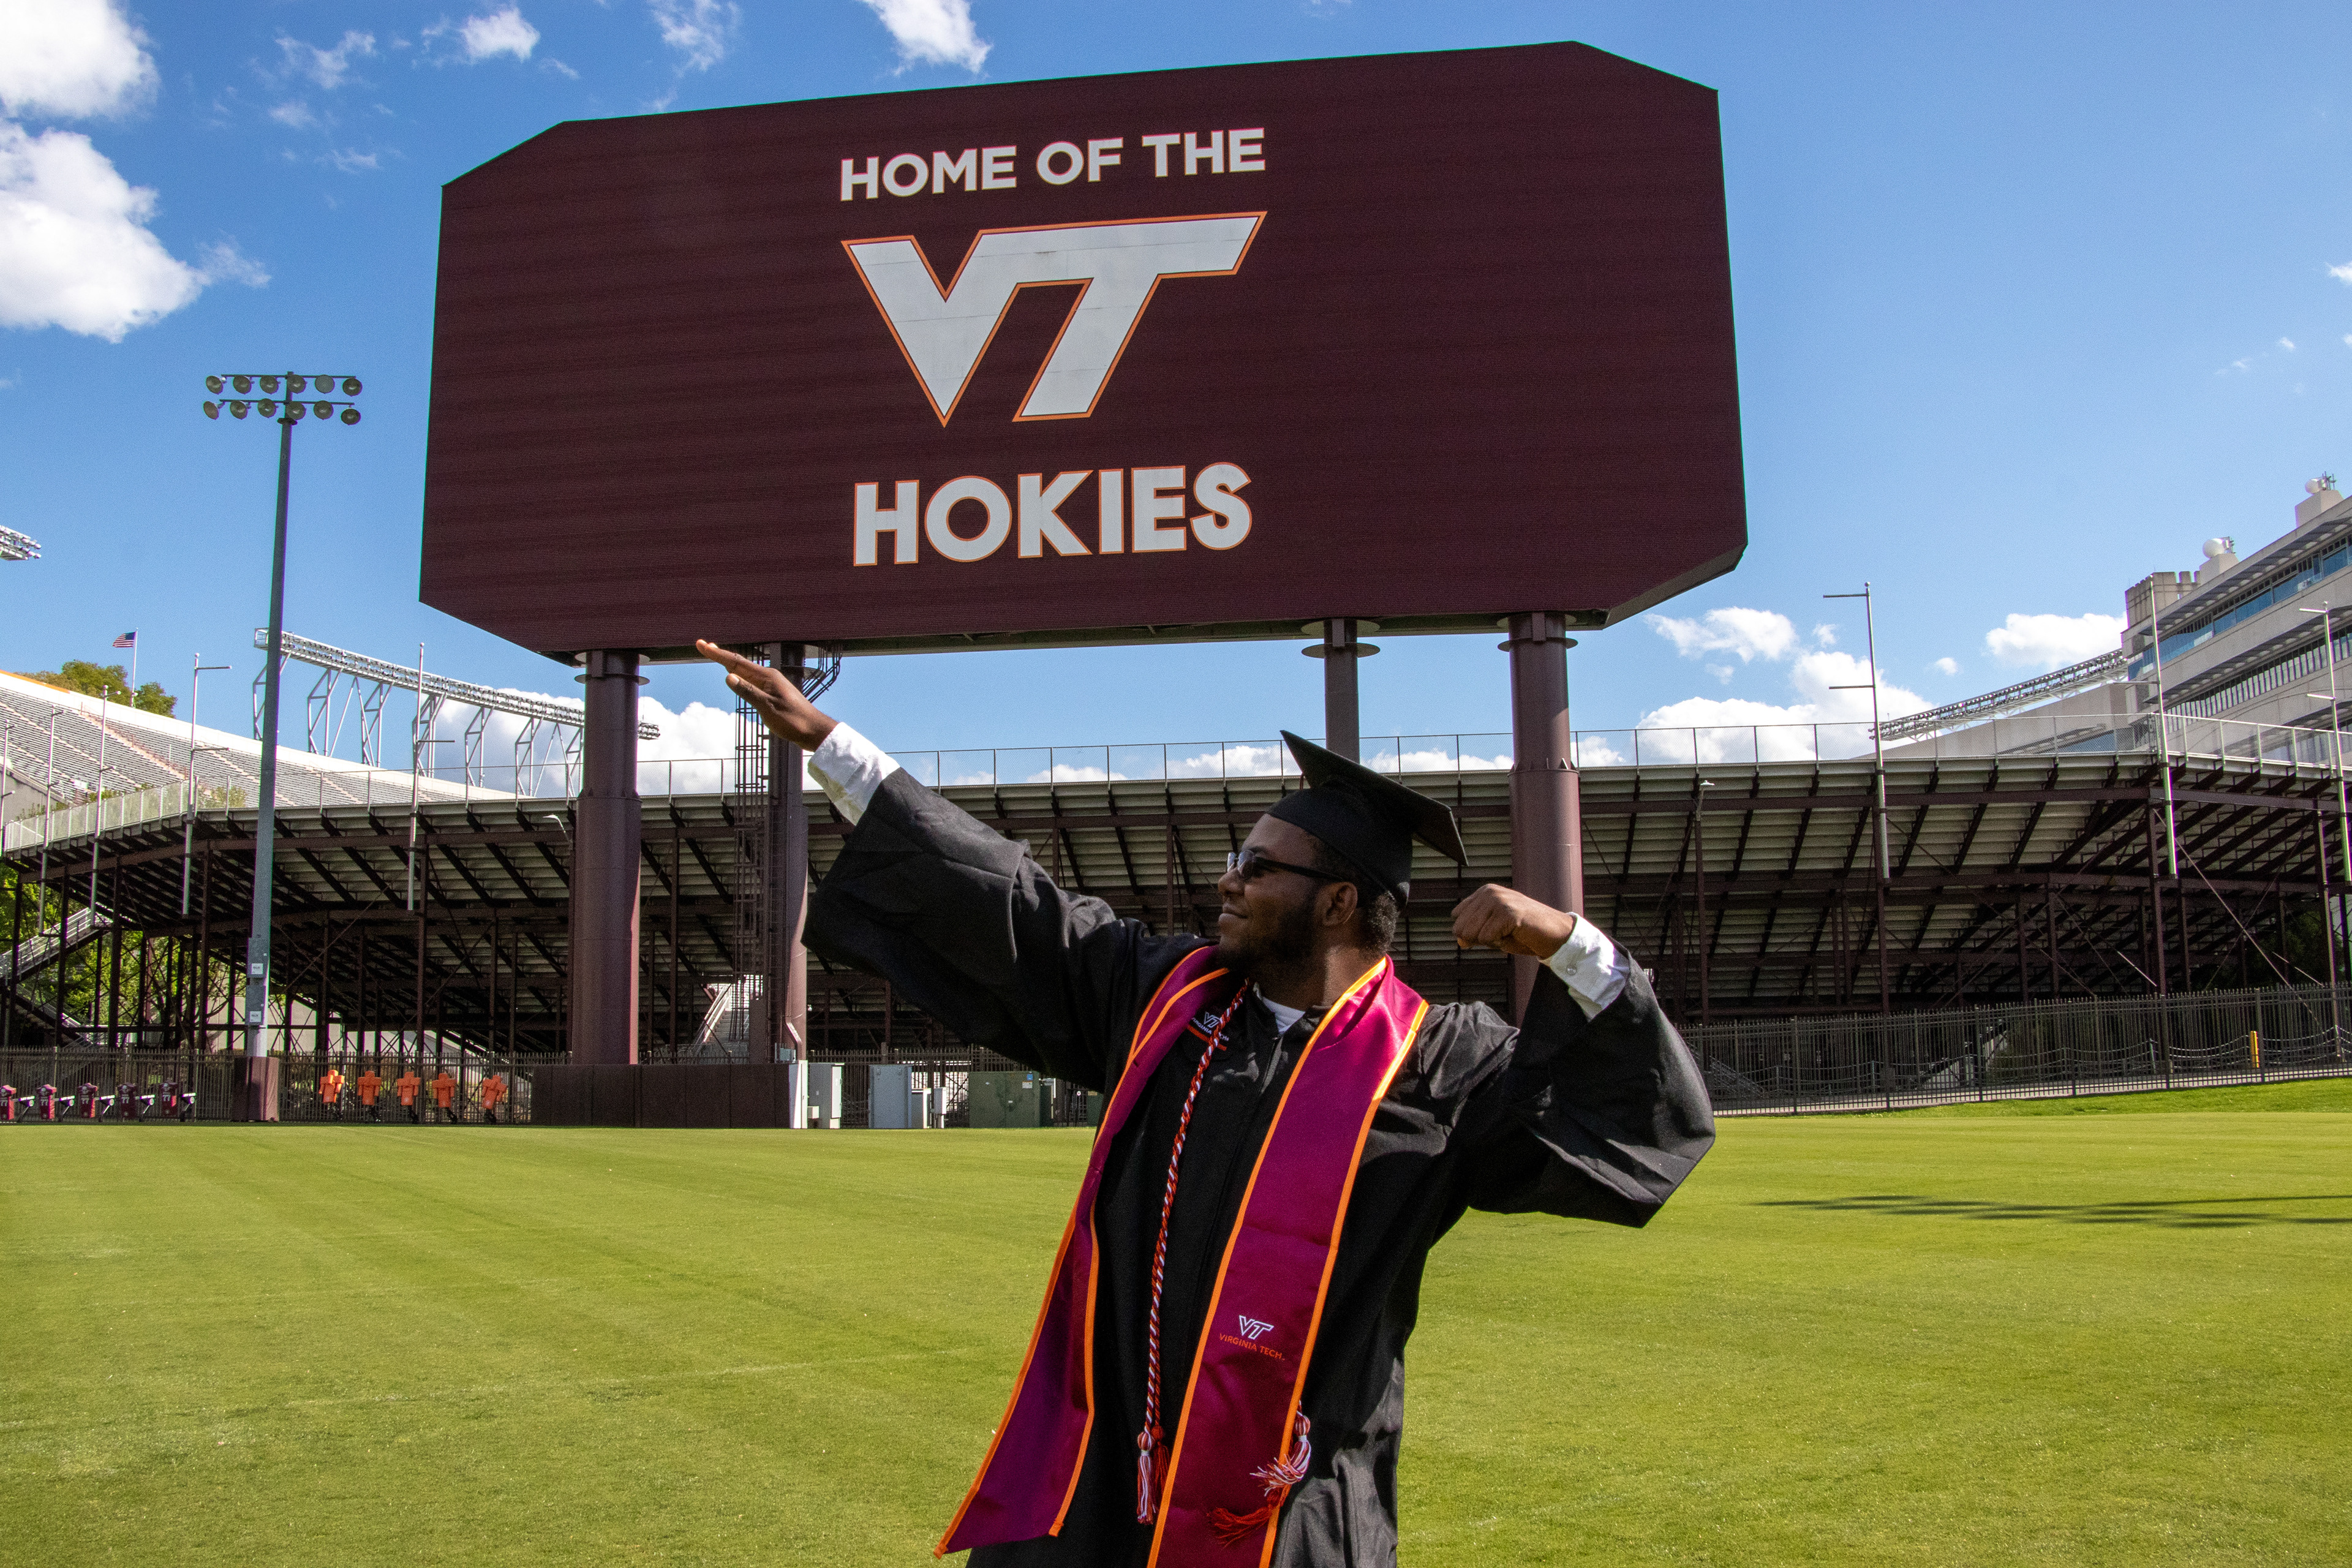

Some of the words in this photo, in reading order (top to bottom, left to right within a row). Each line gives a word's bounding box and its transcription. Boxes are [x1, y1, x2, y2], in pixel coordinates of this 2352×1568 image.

[841, 145, 1017, 201] HOME
[1036, 138, 1123, 185] OF
[1142, 128, 1265, 177] THE
[841, 211, 1268, 428] VT
[854, 462, 1252, 566] HOKIES
[1219, 1333, 1257, 1351] VIRGINIA
[1260, 1346, 1283, 1359] TECH
[1239, 1315, 1274, 1340] VT
